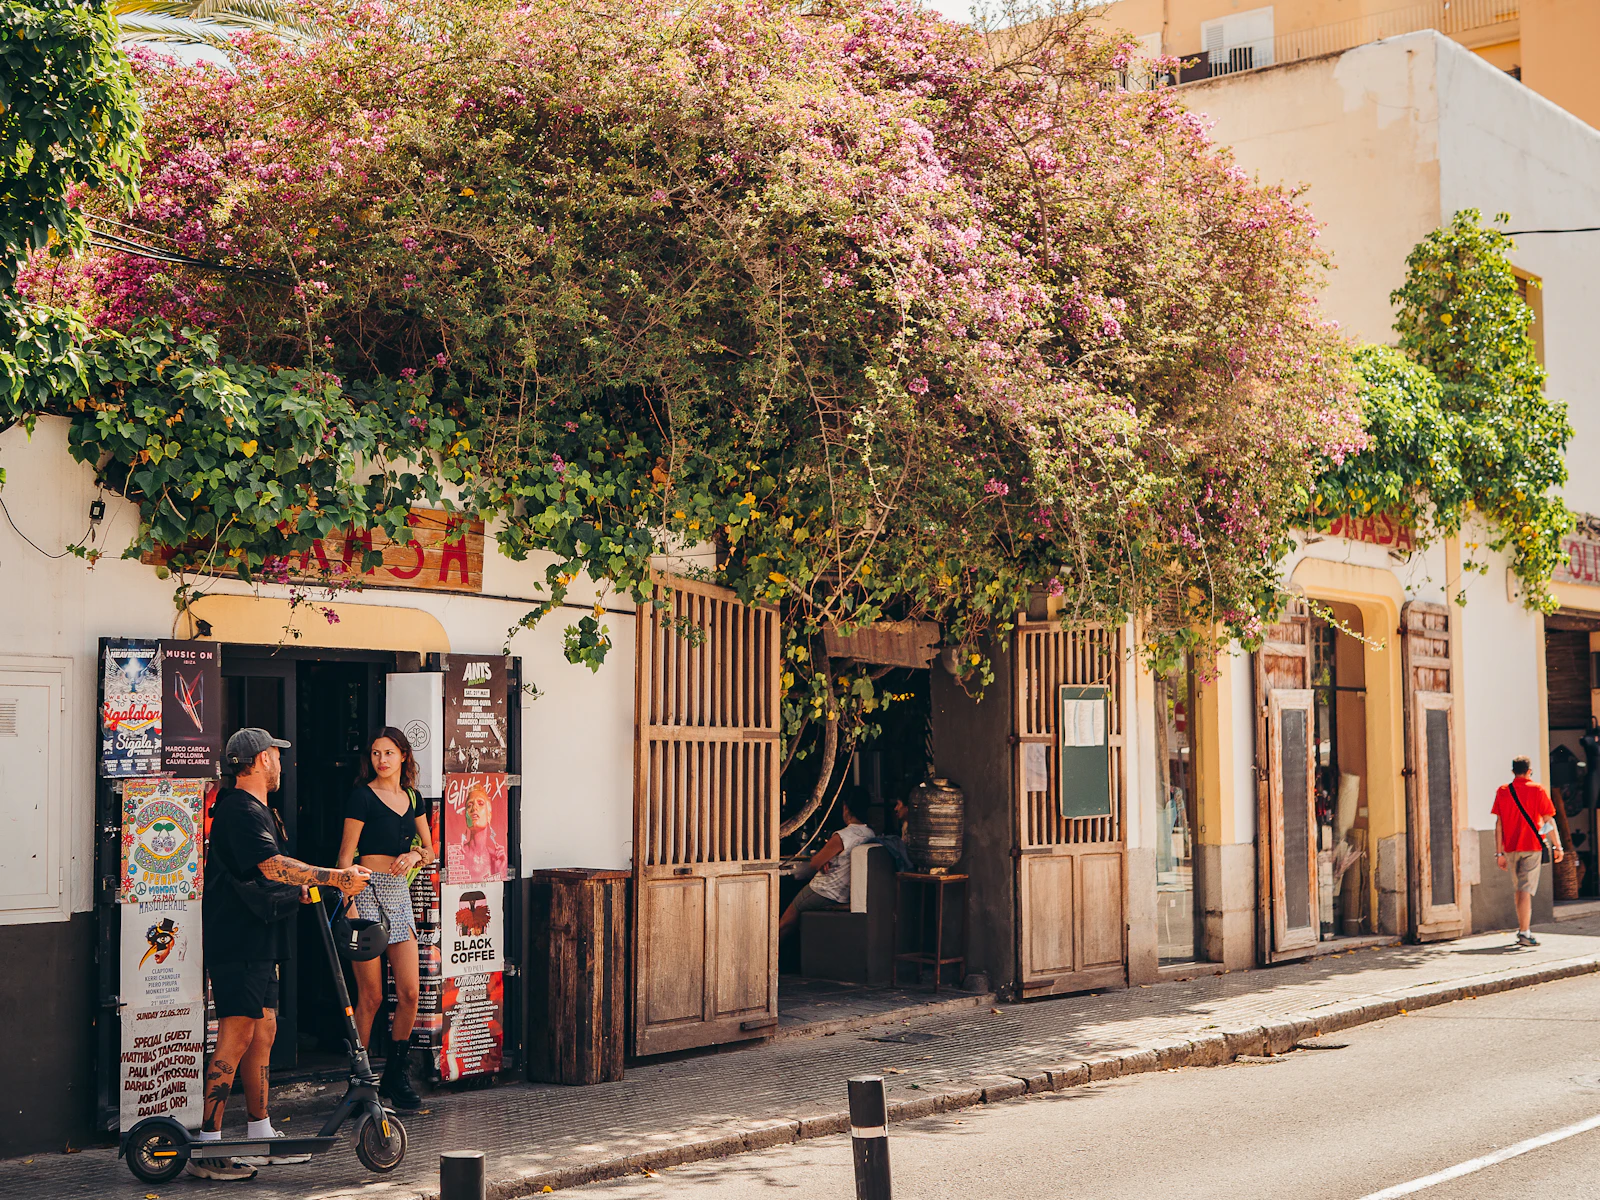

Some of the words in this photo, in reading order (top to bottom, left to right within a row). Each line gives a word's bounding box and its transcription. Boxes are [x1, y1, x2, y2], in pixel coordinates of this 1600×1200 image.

[110, 651, 156, 659] HEAVENSENT
[166, 650, 196, 659] MUSIC
[200, 652, 213, 660] ON
[462, 662, 492, 682] ANTS
[143, 870, 185, 885] OPENING
[149, 885, 179, 895] MONDAY
[162, 893, 177, 902] MAY
[139, 900, 188, 915] MASQUERADE
[454, 938, 492, 952] BLACK
[451, 950, 495, 964] COFFEE
[459, 984, 487, 992] OPENING
[136, 1011, 159, 1021] SUNDAY
[472, 1005, 499, 1013] EVERYTHING
[133, 1034, 162, 1048] SPECIAL
[164, 1030, 192, 1042] GUEST
[120, 1048, 157, 1064] MATTHIAS
[158, 1042, 204, 1058] TANZMANN
[128, 1066, 149, 1078] PAUL
[150, 1055, 196, 1076] WOOLFORD
[124, 1079, 155, 1091] DARIUS
[138, 1091, 159, 1105] JOEY
[160, 1081, 187, 1099] DANIEL
[137, 1102, 169, 1117] DANIEL
[169, 1096, 188, 1110] ORPI
